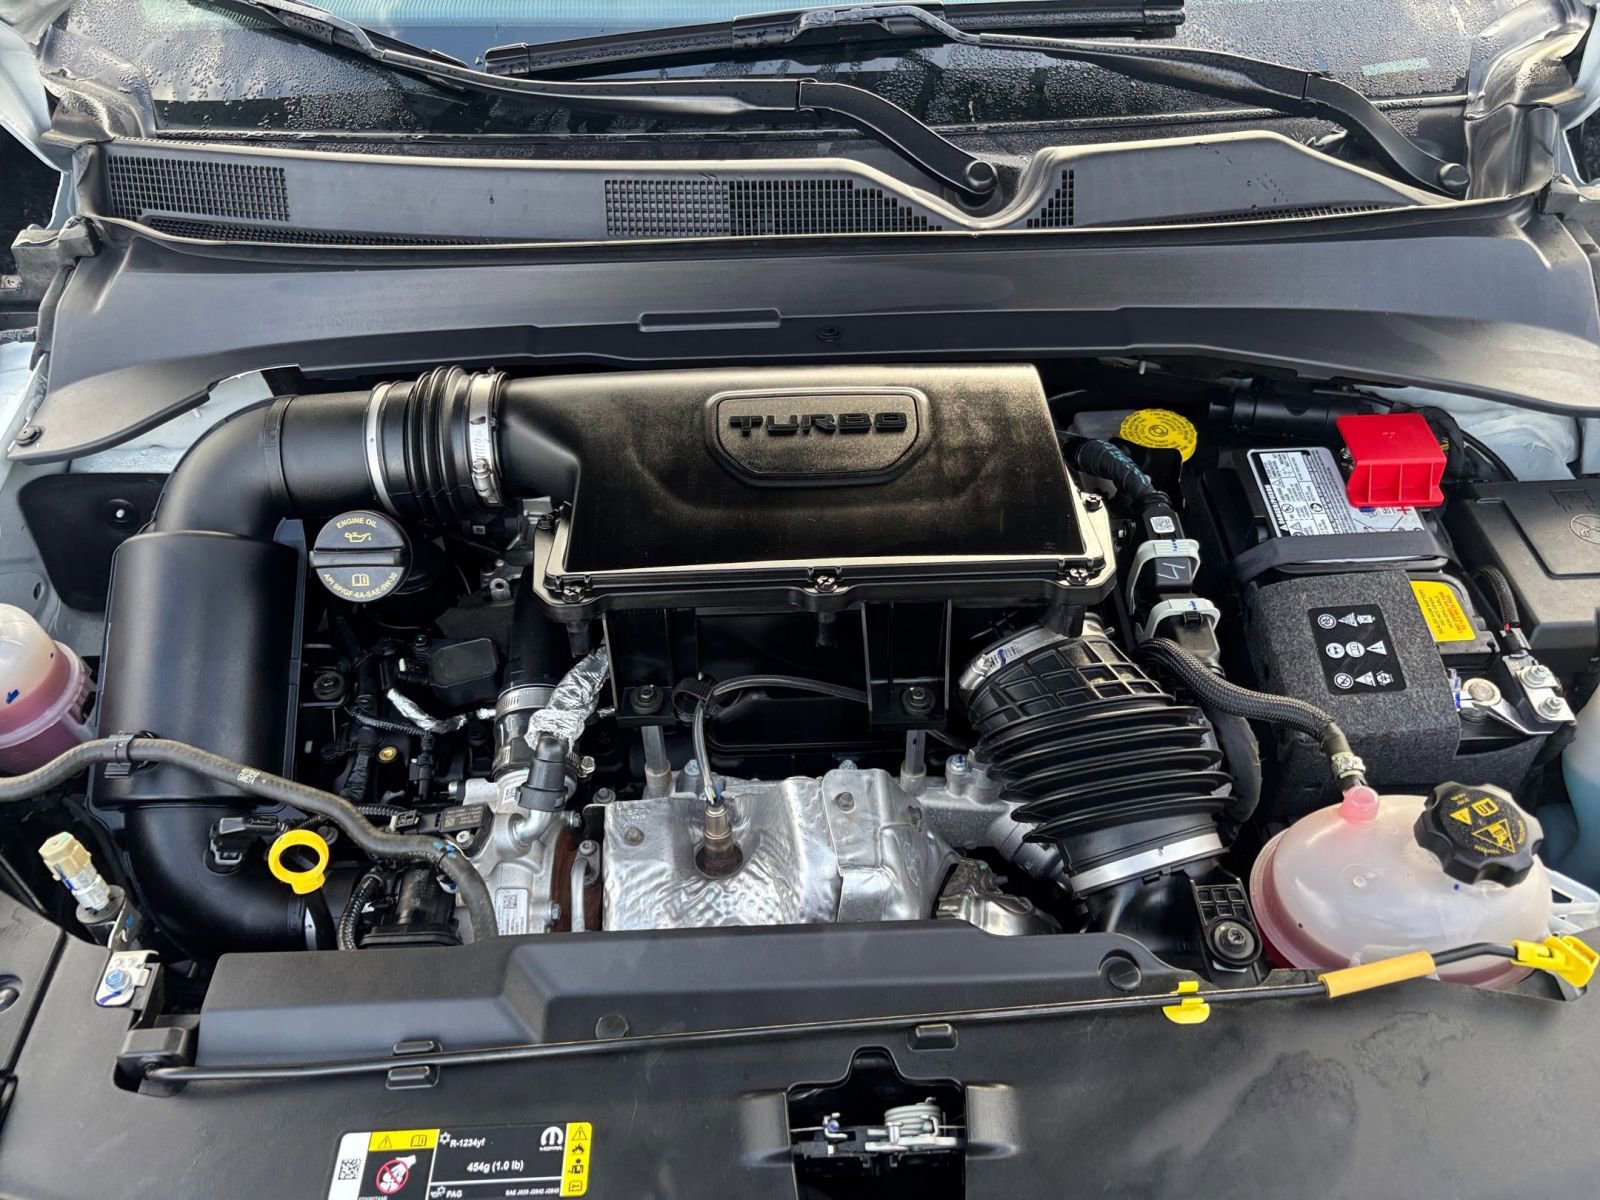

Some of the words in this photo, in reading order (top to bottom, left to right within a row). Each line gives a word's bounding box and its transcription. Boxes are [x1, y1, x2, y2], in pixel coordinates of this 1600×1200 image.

[729, 412, 907, 437] TURBO
[336, 517, 365, 529] ENGINE
[365, 518, 378, 528] OIL
[323, 574, 335, 585] API
[450, 1138, 486, 1149] R-1234yf
[466, 1162, 491, 1174] 454g
[492, 1161, 509, 1173] (1.0
[511, 1160, 524, 1172] lb)
[446, 1190, 462, 1198] PAG
